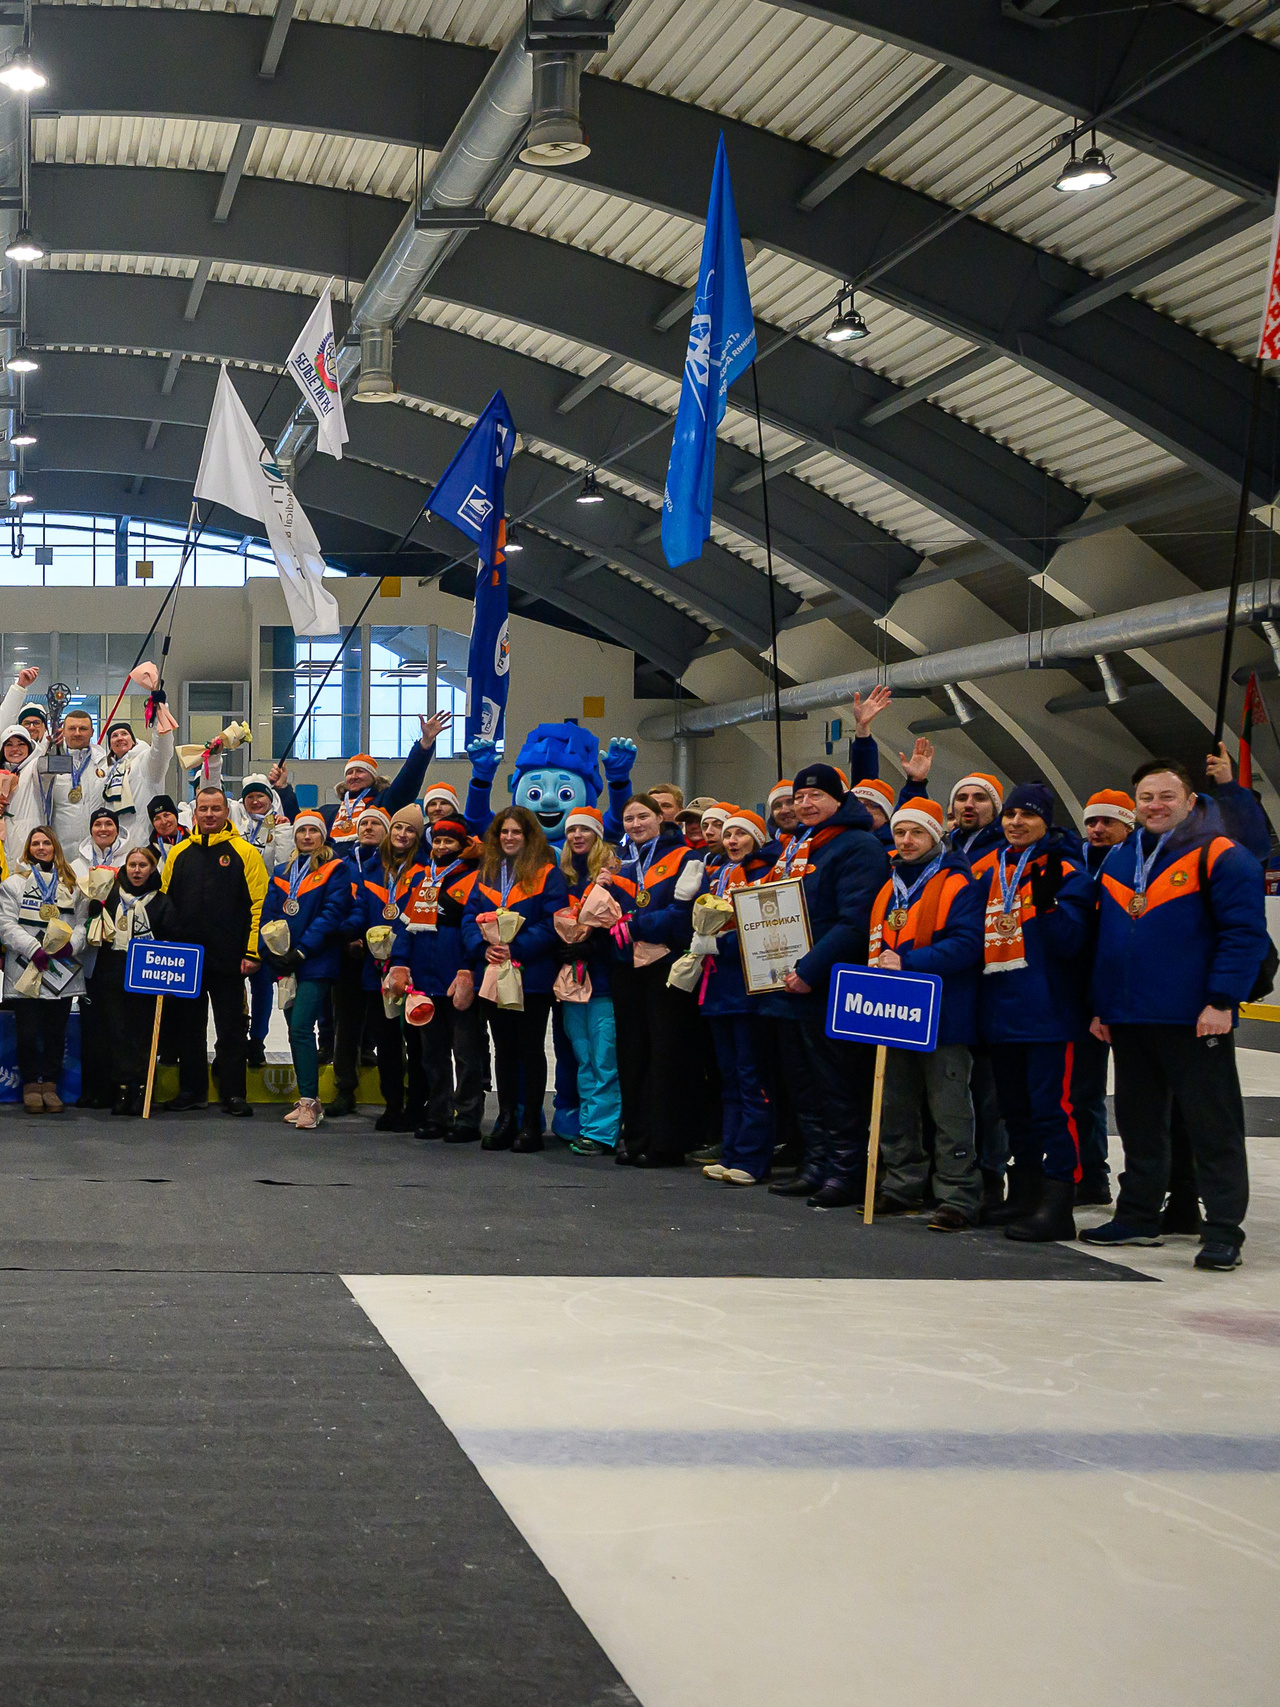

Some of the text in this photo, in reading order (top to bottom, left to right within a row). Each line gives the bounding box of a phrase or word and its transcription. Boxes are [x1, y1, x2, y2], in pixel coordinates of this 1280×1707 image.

[295, 352, 334, 415] БЕЛЫЕ ТИГРЫ
[744, 914, 800, 932] СЕРТИФИКАТ
[145, 950, 185, 967] Белые
[142, 969, 186, 985] тигры
[845, 992, 922, 1022] Молния
